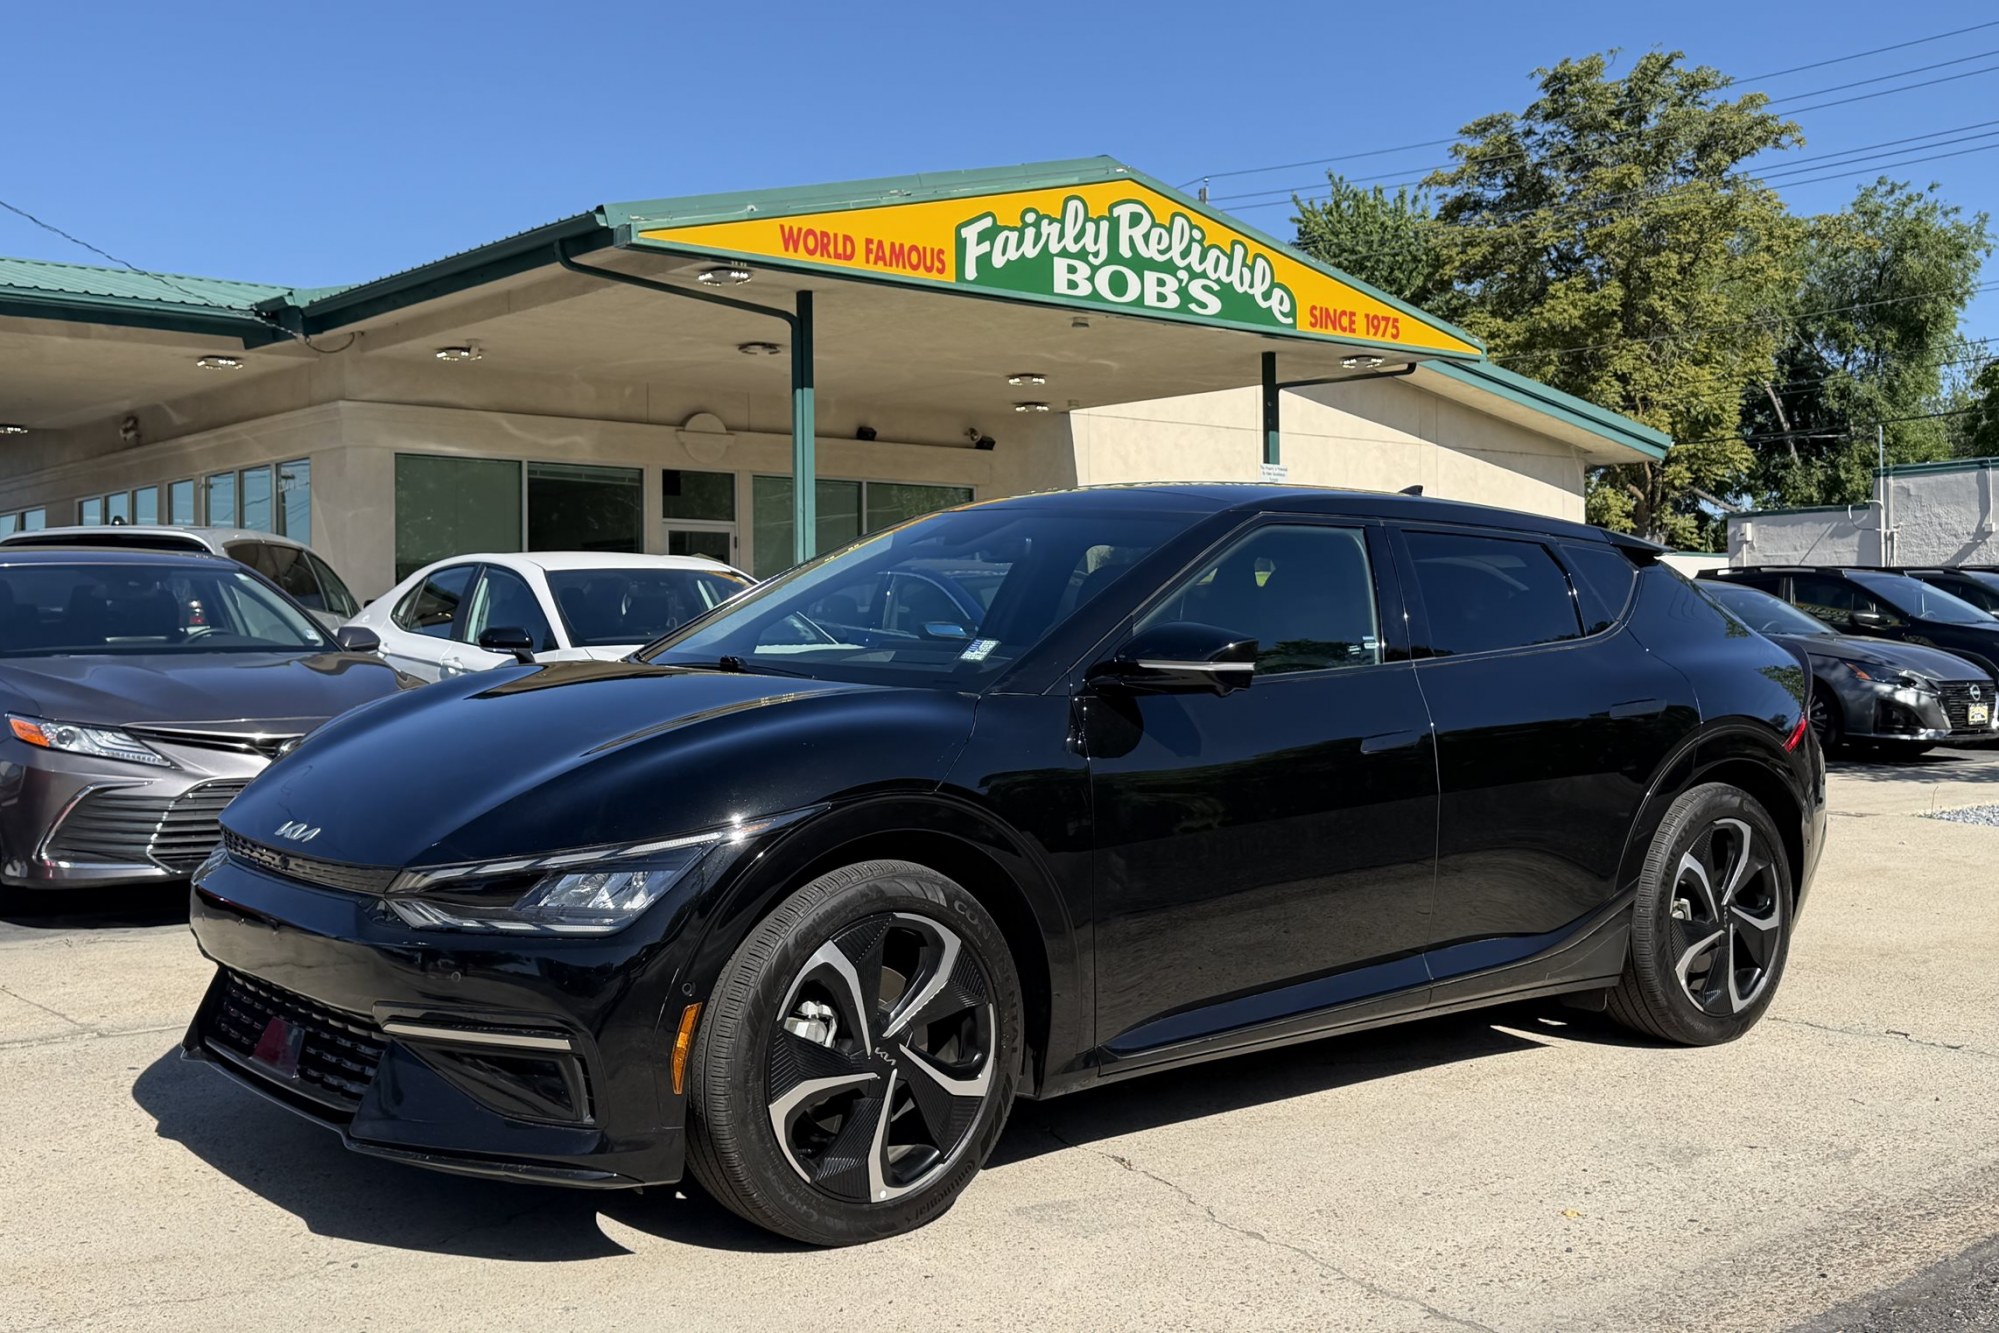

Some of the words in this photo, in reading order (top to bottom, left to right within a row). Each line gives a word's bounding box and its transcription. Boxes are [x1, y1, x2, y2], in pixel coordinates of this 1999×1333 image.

[779, 223, 856, 262] WORLD
[864, 237, 946, 275] FAMOUS
[960, 199, 1109, 281] Fairly
[1112, 203, 1294, 324] Reliable
[1053, 256, 1222, 316] BOB'S
[1309, 304, 1357, 334] SINCE
[1364, 313, 1400, 340] 1975
